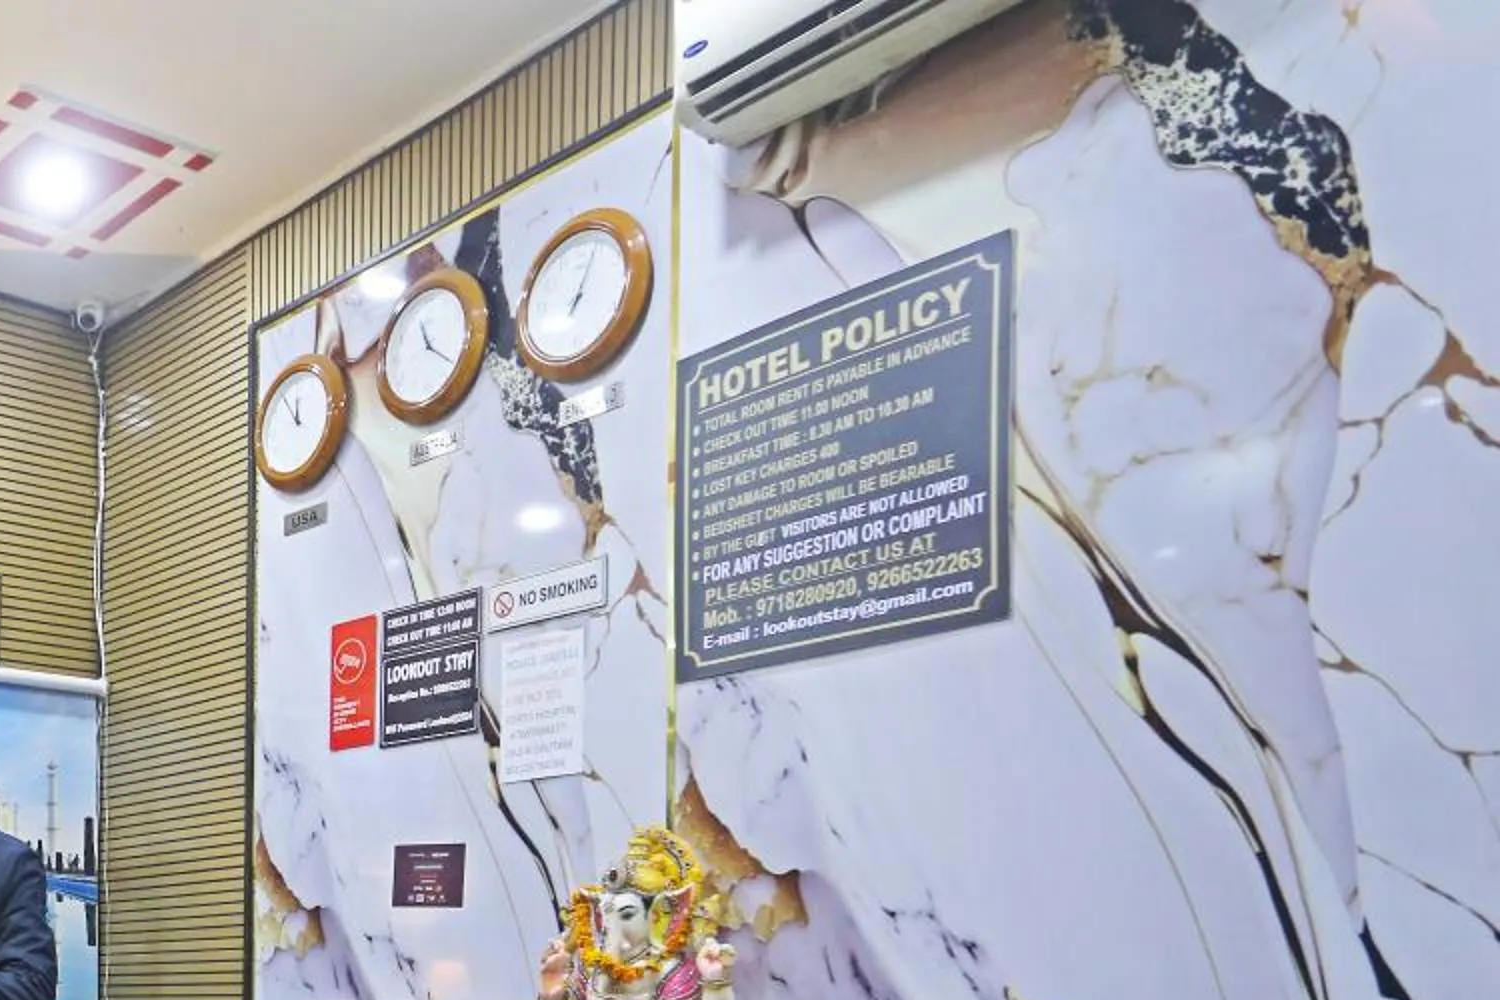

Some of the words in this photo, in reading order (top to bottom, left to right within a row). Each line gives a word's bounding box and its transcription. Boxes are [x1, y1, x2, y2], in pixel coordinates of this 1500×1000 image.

[699, 342, 810, 408] HOTEL
[821, 276, 971, 362] POLICY
[704, 411, 739, 432] TOTAL
[741, 396, 775, 419] ROOM
[778, 384, 810, 407] RENT
[812, 378, 824, 394] IS
[826, 355, 884, 390] PAYABLE
[887, 352, 901, 369] IN
[904, 325, 972, 363] ADVANCE
[703, 441, 770, 476] BREAKFAST
[835, 414, 854, 432] AM
[857, 407, 874, 424] TO
[912, 387, 934, 408] AM
[704, 430, 742, 453] CHECK
[745, 421, 768, 440] OUT
[770, 409, 799, 430] TIME
[832, 385, 868, 411] NOON
[703, 500, 726, 518] ANY
[727, 484, 777, 511] DAMAGE
[780, 478, 796, 494] TO
[798, 465, 835, 488] ROOM
[837, 459, 858, 477] OR
[859, 441, 919, 471] SPOILED
[703, 509, 763, 538] BEDSHEET
[765, 491, 823, 520] CHARGES
[825, 484, 855, 504] WILL
[858, 476, 877, 494] BE
[880, 453, 956, 489] BEARABLE
[704, 476, 732, 496] LOST
[734, 468, 757, 486] KEY
[760, 448, 817, 479] CHARGES
[291, 510, 318, 528] USA
[703, 544, 718, 560] BY
[721, 537, 742, 555] THE
[780, 511, 837, 538] VISITORS
[840, 502, 867, 523] ARE
[869, 493, 898, 515] NOT
[898, 474, 969, 507] ALLOWED
[703, 561, 730, 584] FOR
[732, 552, 762, 576] ANY
[763, 526, 859, 568] SUGGESTION
[861, 519, 885, 543] OR
[888, 492, 987, 535] COMPLAINT
[519, 590, 536, 606] NO
[539, 574, 597, 602] SMOKING
[703, 607, 741, 629] Mob.
[867, 548, 982, 591] 9266522263
[705, 573, 773, 604] PLEASE
[778, 549, 869, 585] CONTACT
[876, 540, 905, 561] US
[909, 532, 937, 556] AT
[703, 625, 750, 649] E-mail
[763, 581, 973, 637] lookoutstay@gmail.com
[387, 656, 441, 685] LOOKOUT
[444, 649, 475, 673] STAY
